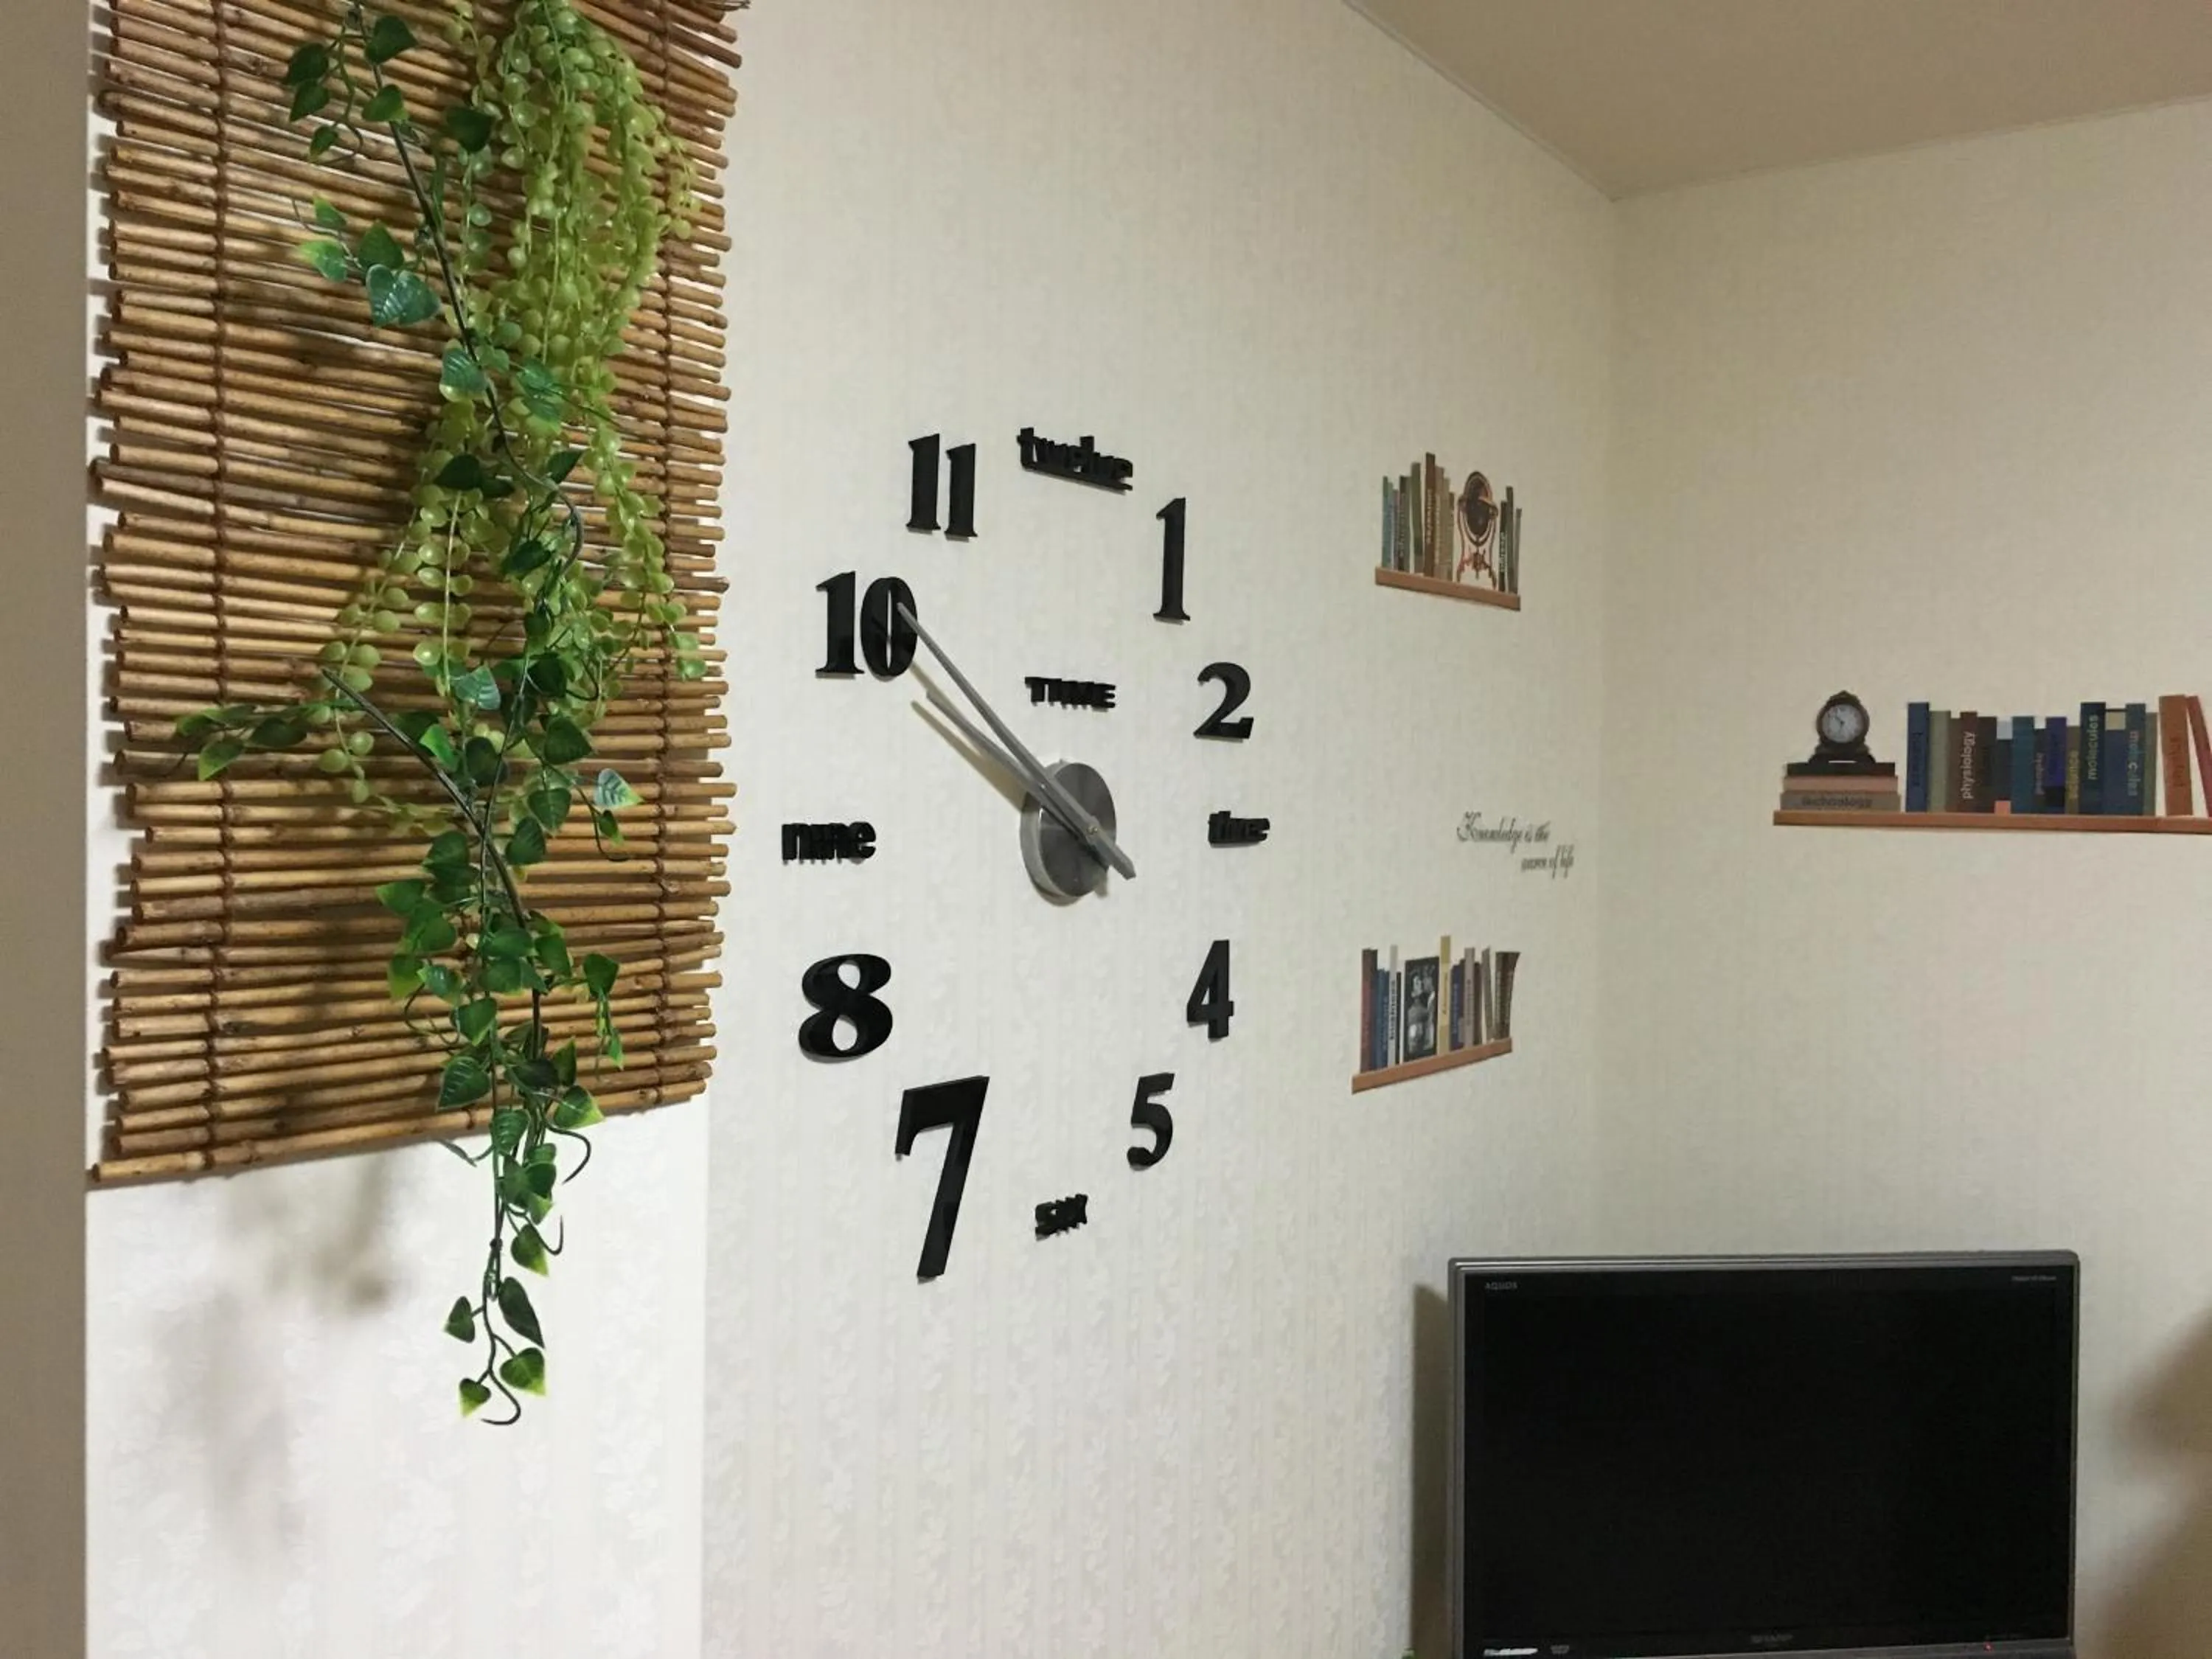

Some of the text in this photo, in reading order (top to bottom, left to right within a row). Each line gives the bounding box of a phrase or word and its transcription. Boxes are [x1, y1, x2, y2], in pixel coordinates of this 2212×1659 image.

[906, 434, 978, 538] 11
[1152, 497, 1190, 622] 1
[815, 571, 918, 678] 10
[1193, 662, 1253, 740] 2
[1960, 731, 1977, 800] physiology
[782, 821, 876, 861] nine
[799, 953, 893, 1058] 8
[1186, 939, 1234, 1040] 4
[1127, 1073, 1175, 1168] 5
[895, 1076, 990, 1279] 7
